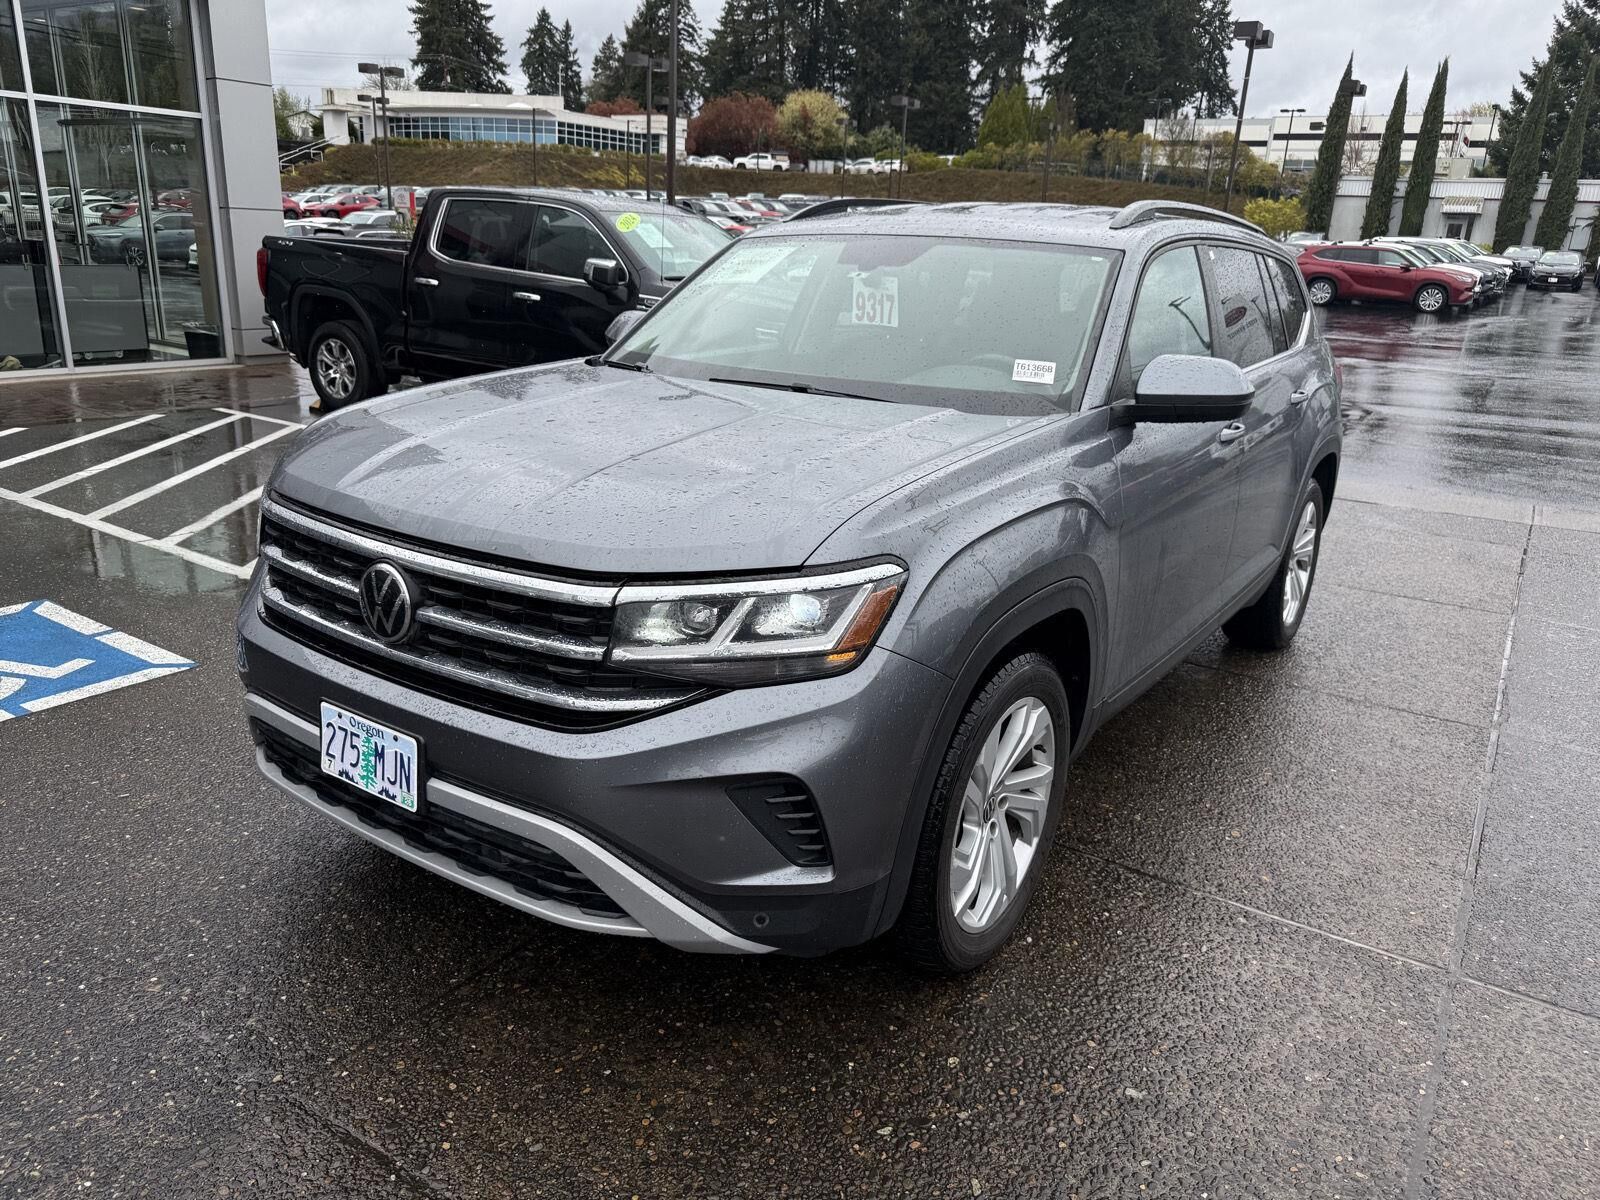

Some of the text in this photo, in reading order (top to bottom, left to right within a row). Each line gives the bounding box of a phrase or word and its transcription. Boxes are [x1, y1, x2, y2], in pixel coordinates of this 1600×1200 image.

[856, 291, 895, 325] 9317
[349, 716, 385, 740] Oregon
[326, 722, 411, 793] 275 MJN
